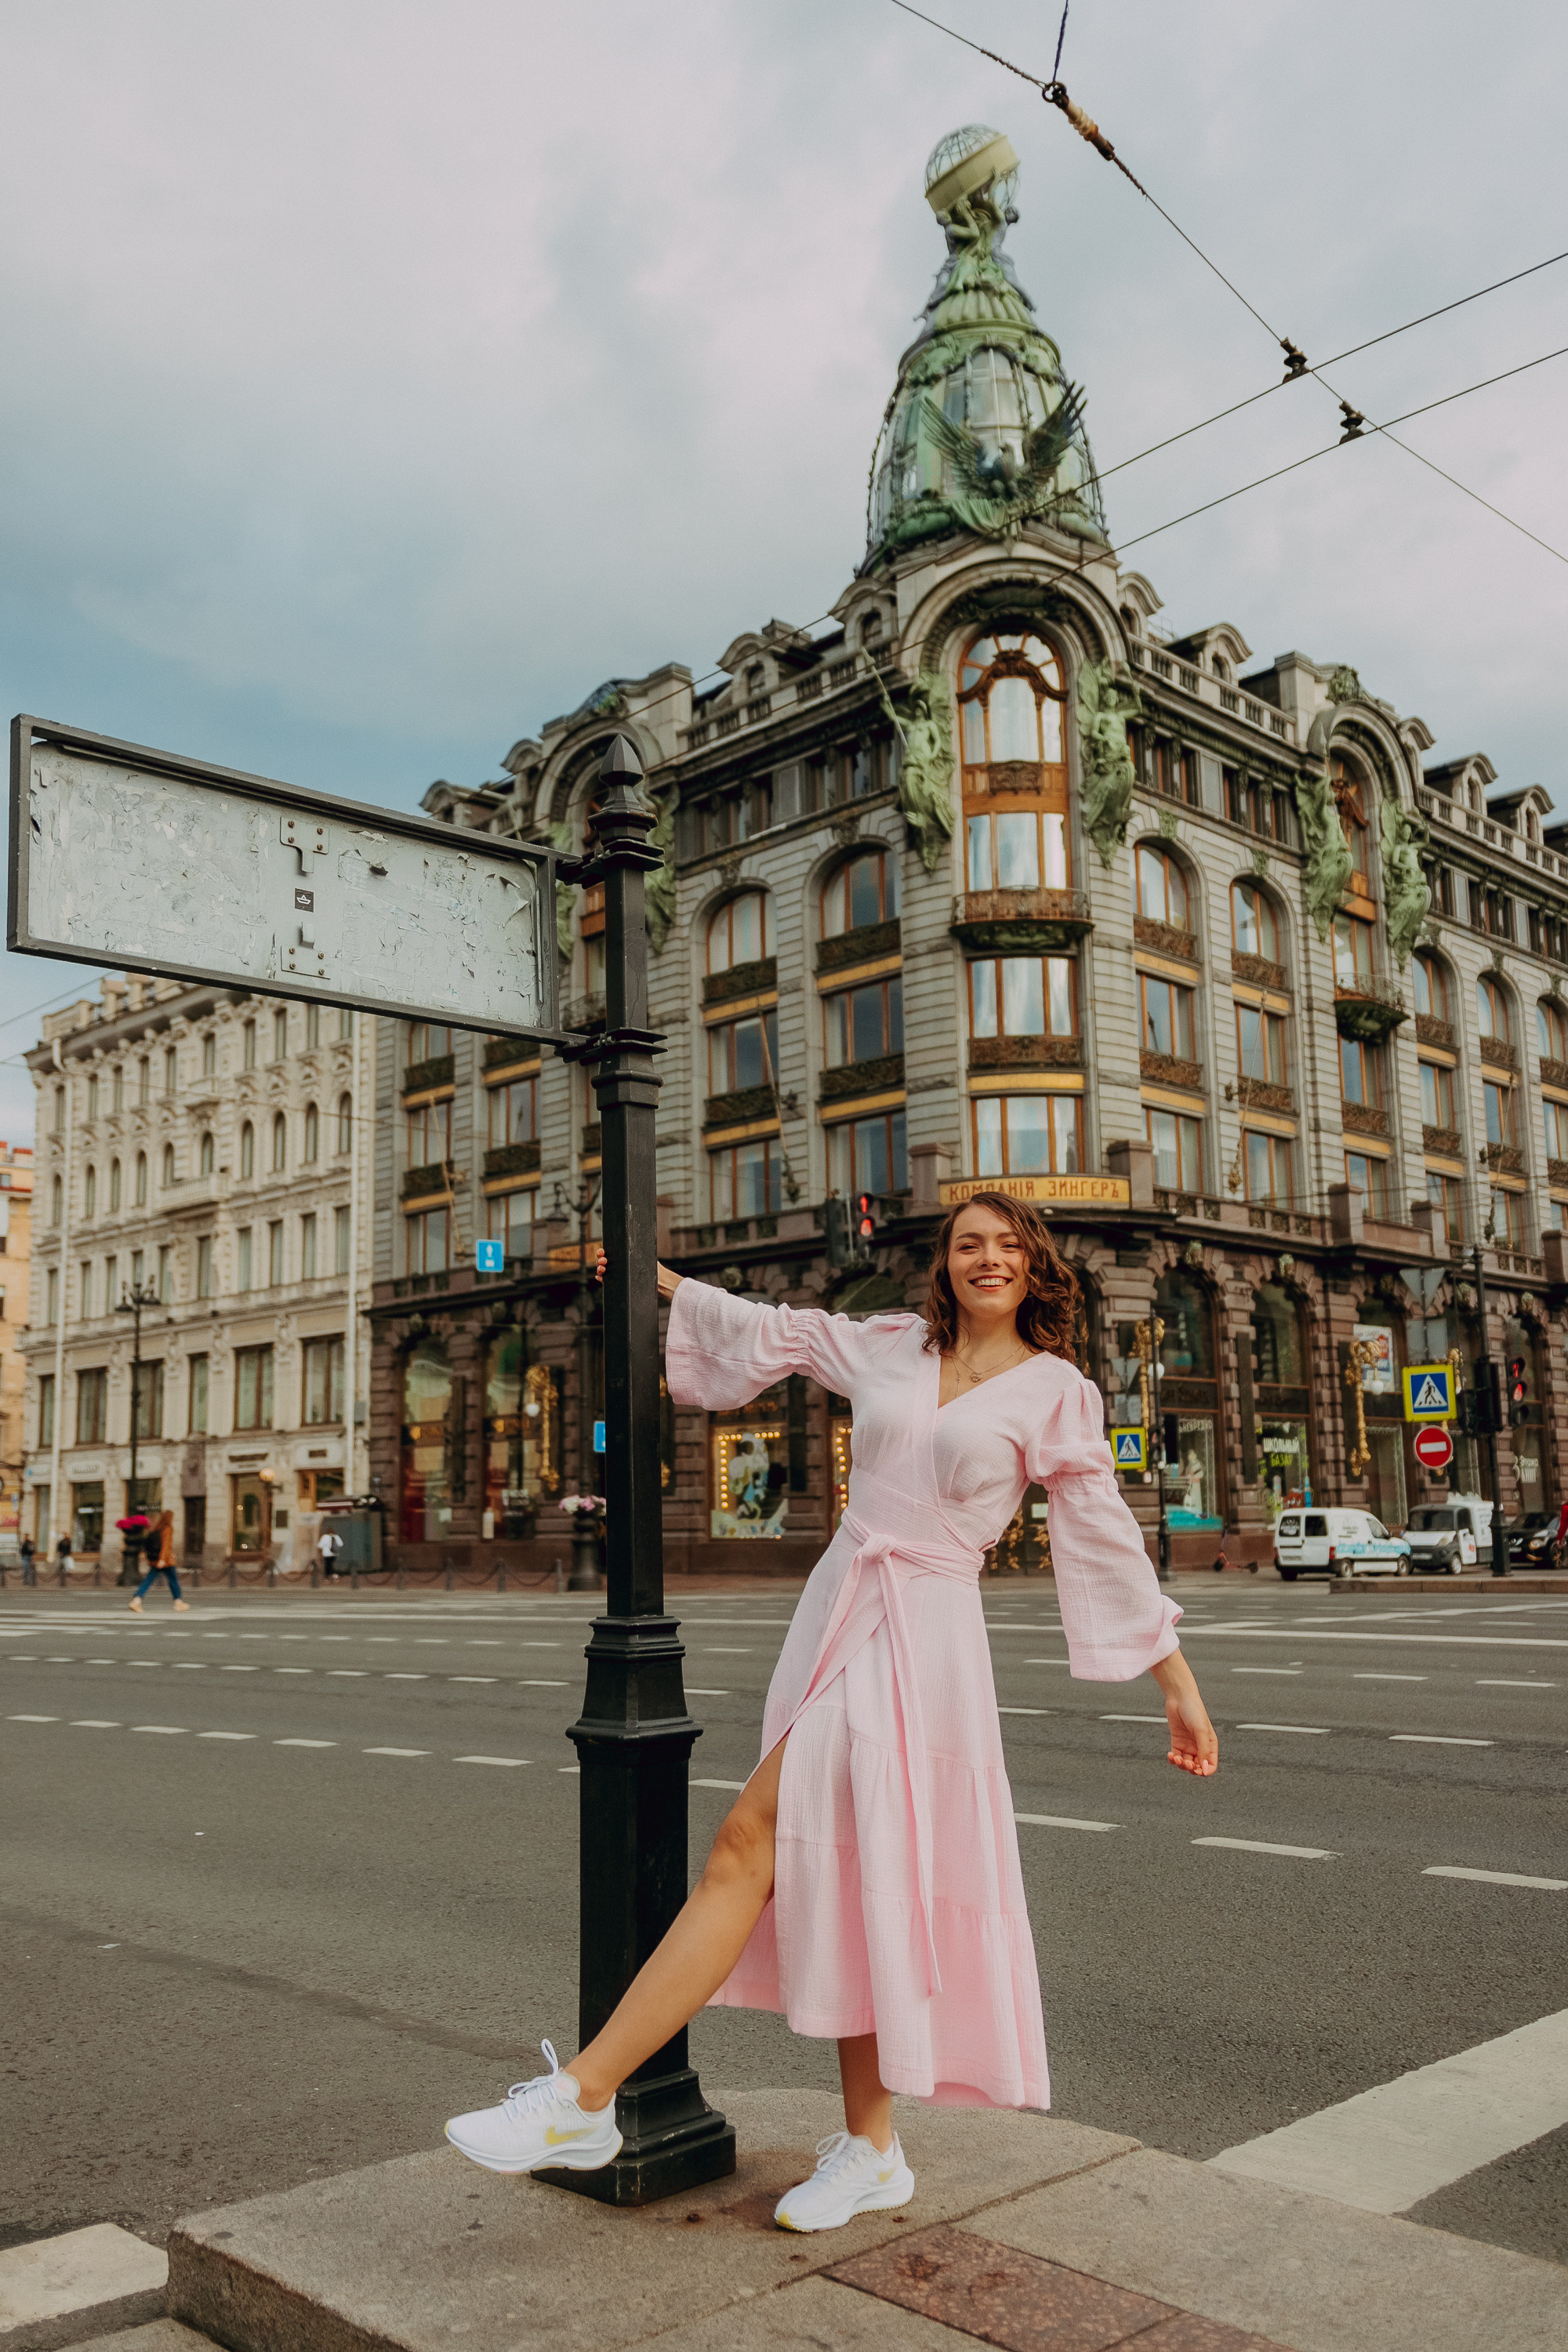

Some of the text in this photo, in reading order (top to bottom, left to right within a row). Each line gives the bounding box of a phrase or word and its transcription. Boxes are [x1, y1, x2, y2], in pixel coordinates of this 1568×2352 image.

[1048, 1180, 1120, 1198] ЗИНГЕРЪ
[1263, 1437, 1300, 1454] ШКОЛЬНЫЙ
[1271, 1453, 1293, 1467] БАЗАР
